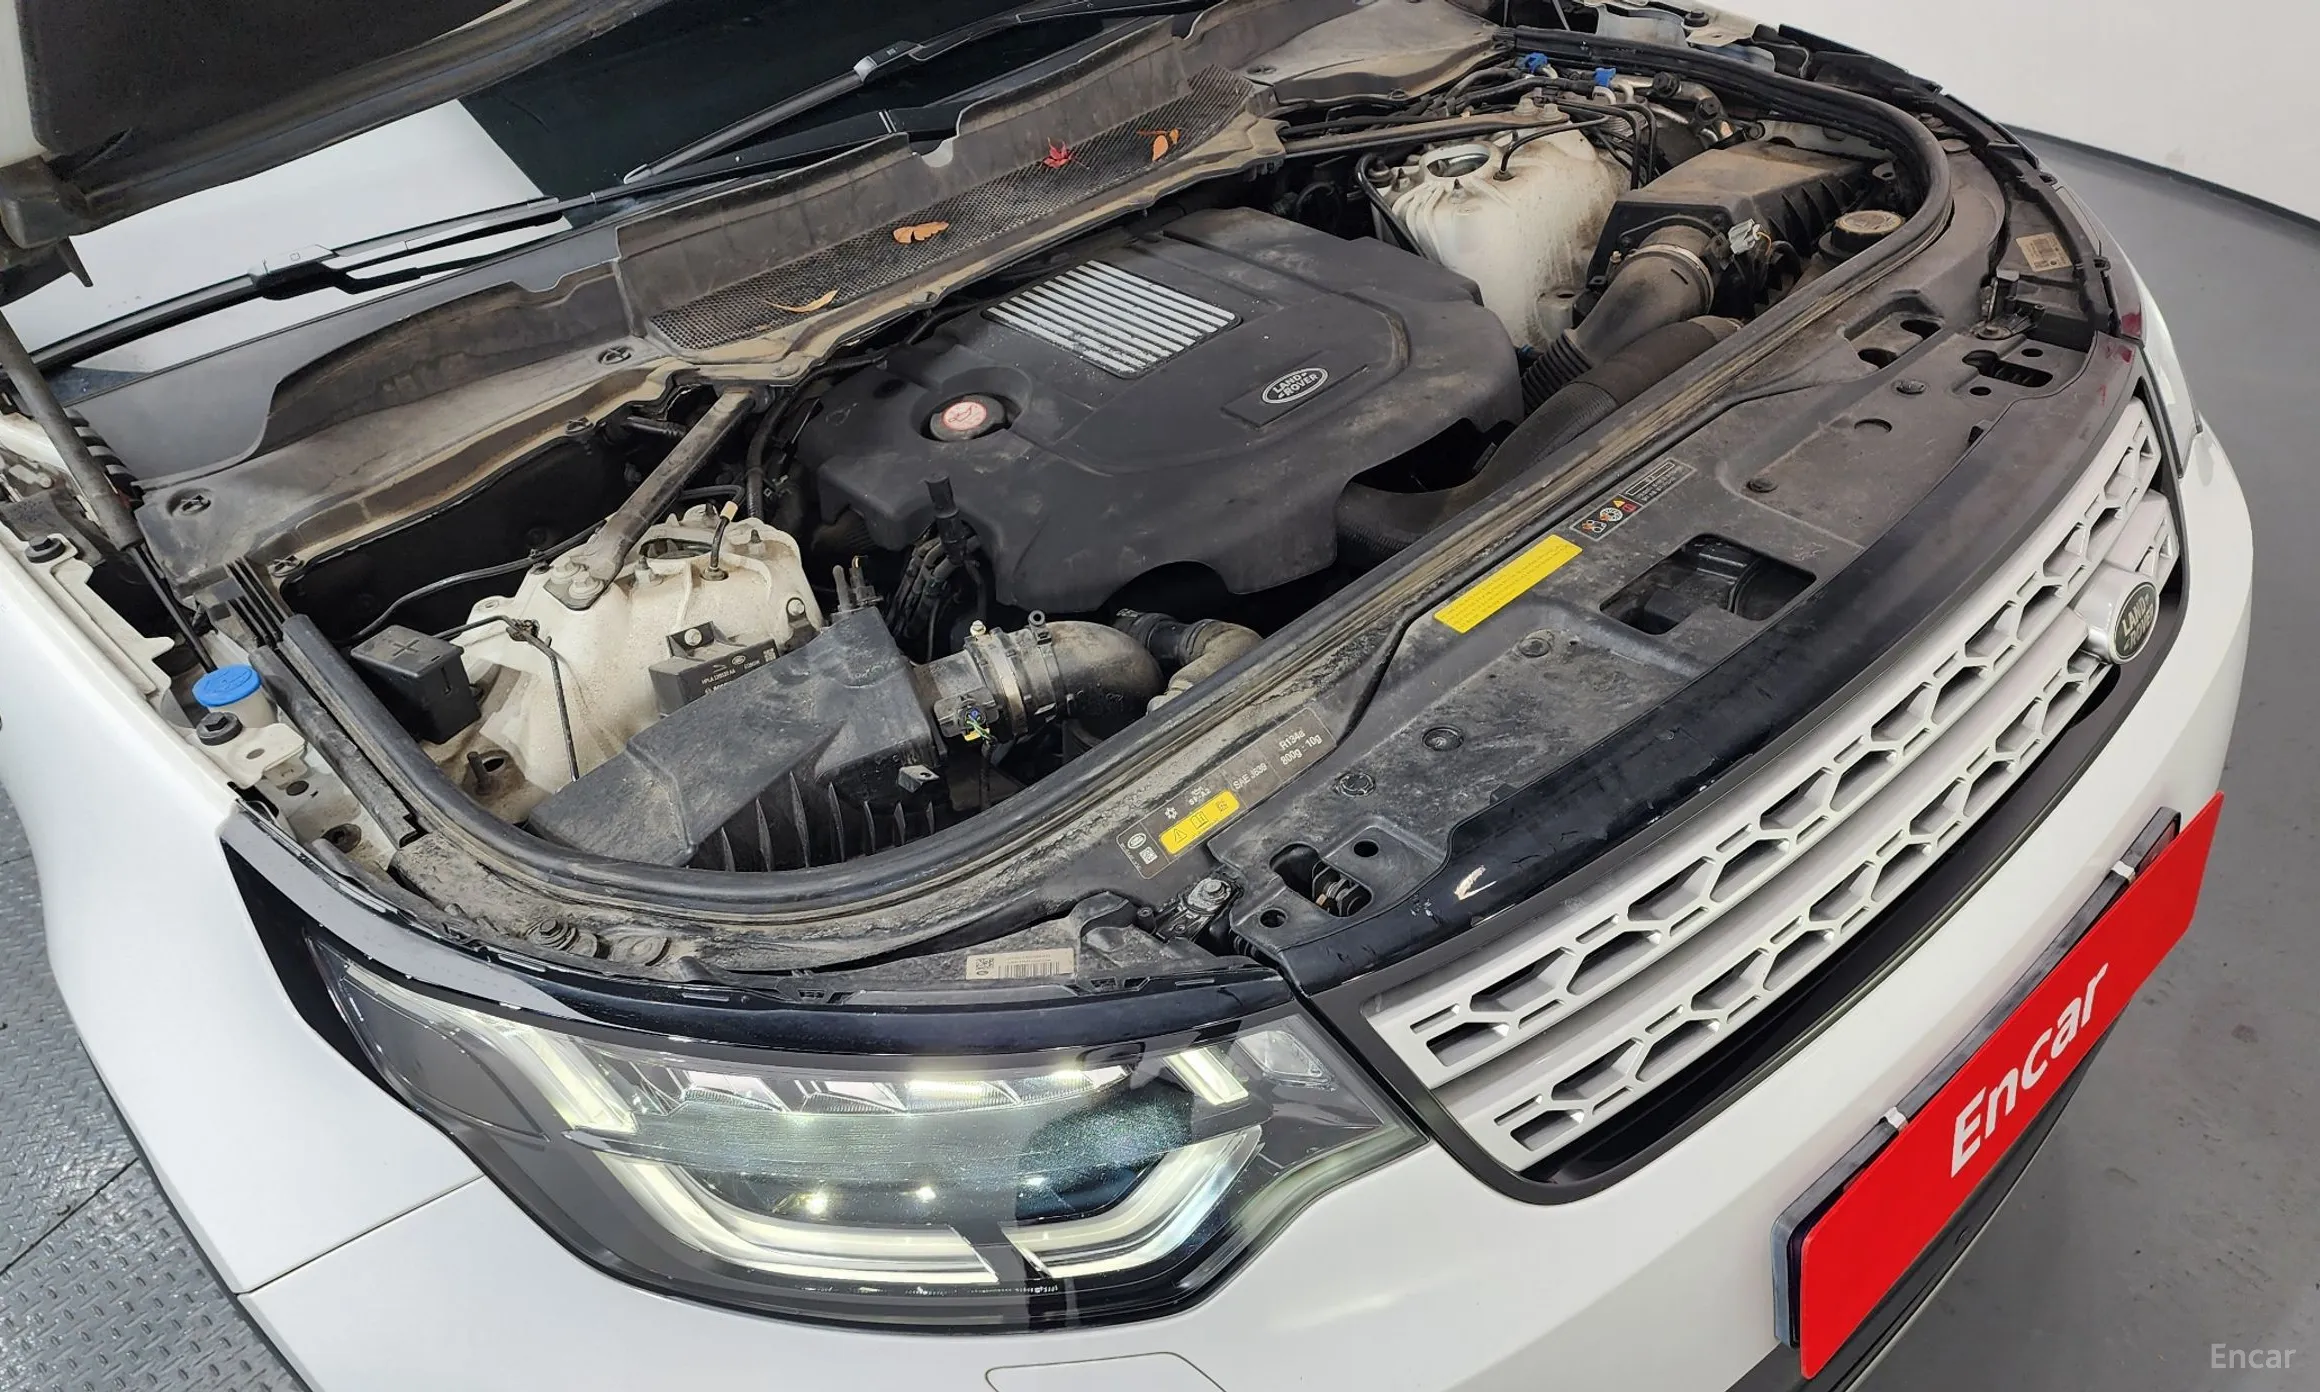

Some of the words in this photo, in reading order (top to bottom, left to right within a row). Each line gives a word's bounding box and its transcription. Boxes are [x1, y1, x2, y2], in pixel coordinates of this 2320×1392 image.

[1273, 373, 1302, 394] LAND
[1283, 373, 1319, 396] ROVER
[2121, 596, 2146, 637] LAND
[2130, 603, 2154, 650] ROVER
[1279, 730, 1306, 751] R134a
[1280, 748, 1303, 765] 800g
[1304, 734, 1323, 748] 10g
[1232, 773, 1251, 790] SAE
[1950, 962, 2109, 1179] Encar
